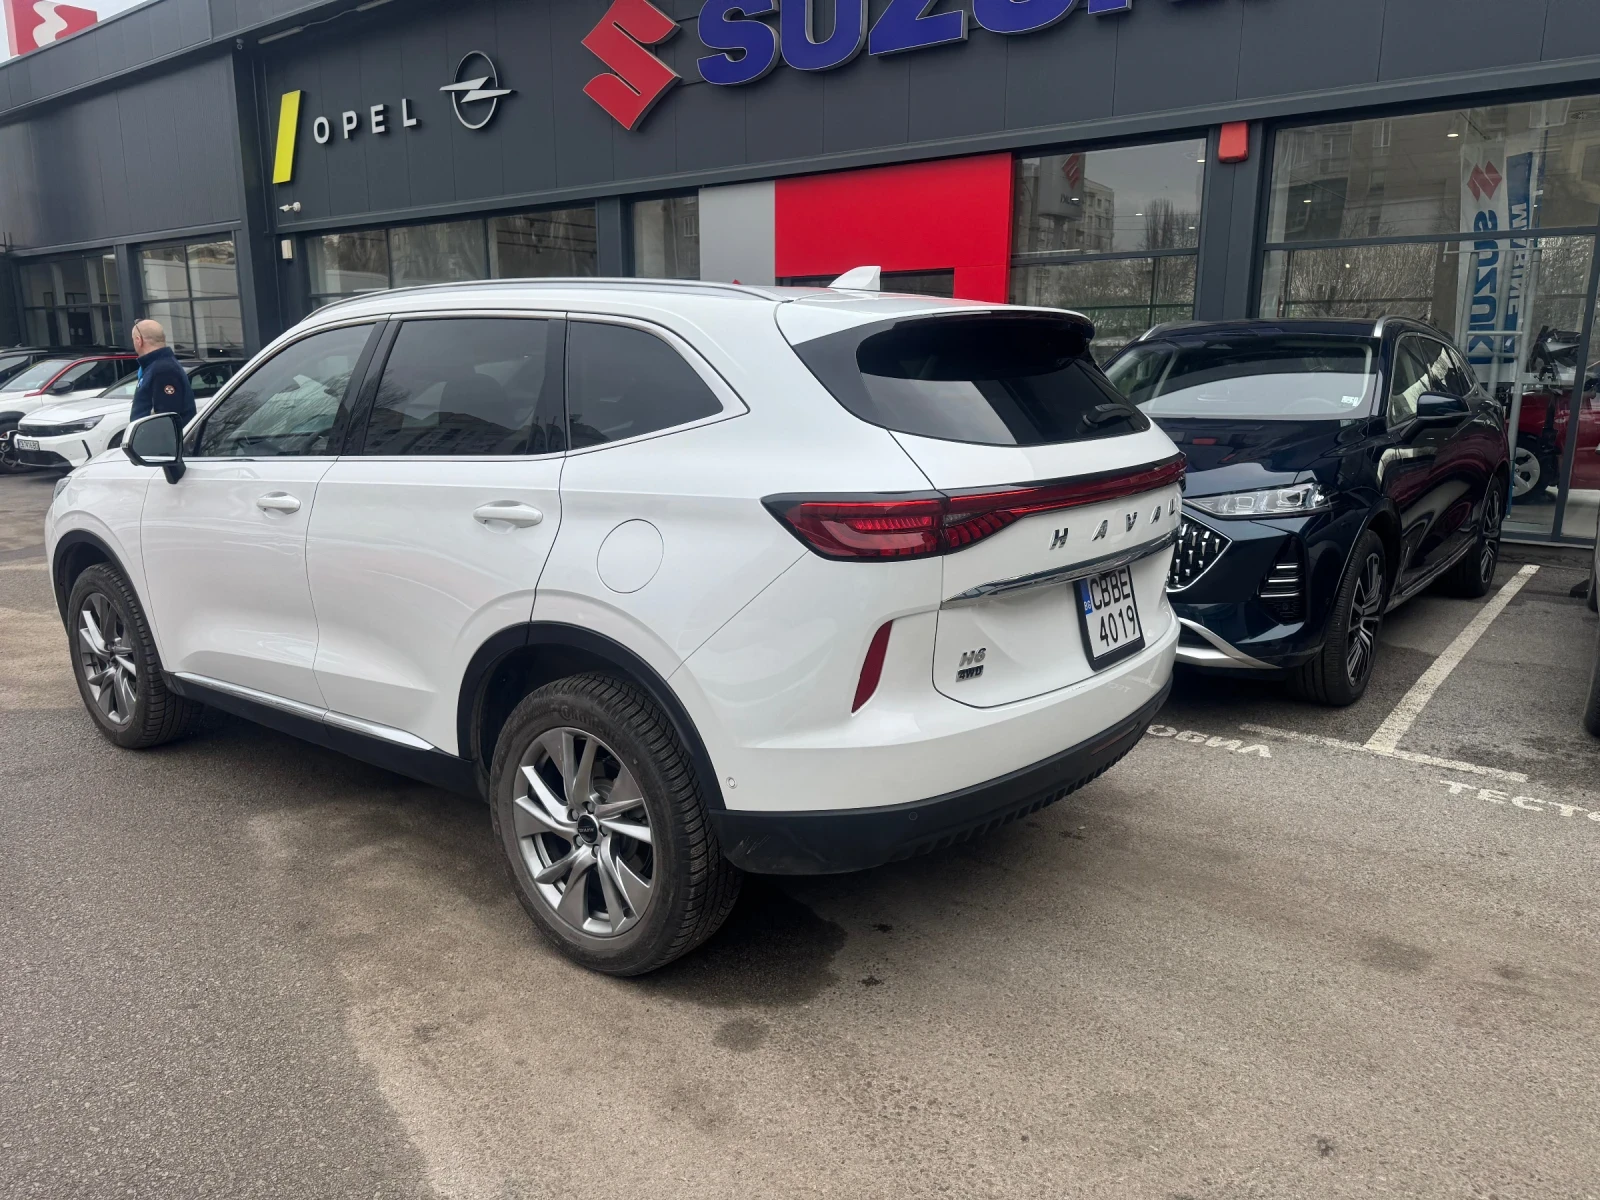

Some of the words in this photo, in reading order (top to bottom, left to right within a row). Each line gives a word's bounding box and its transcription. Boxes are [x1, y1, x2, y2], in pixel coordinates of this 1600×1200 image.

[313, 98, 417, 144] OPEL
[1049, 498, 1176, 550] HAVAL
[1100, 604, 1136, 647] 4019
[957, 665, 984, 681] 4WD
[958, 647, 987, 667] H6
